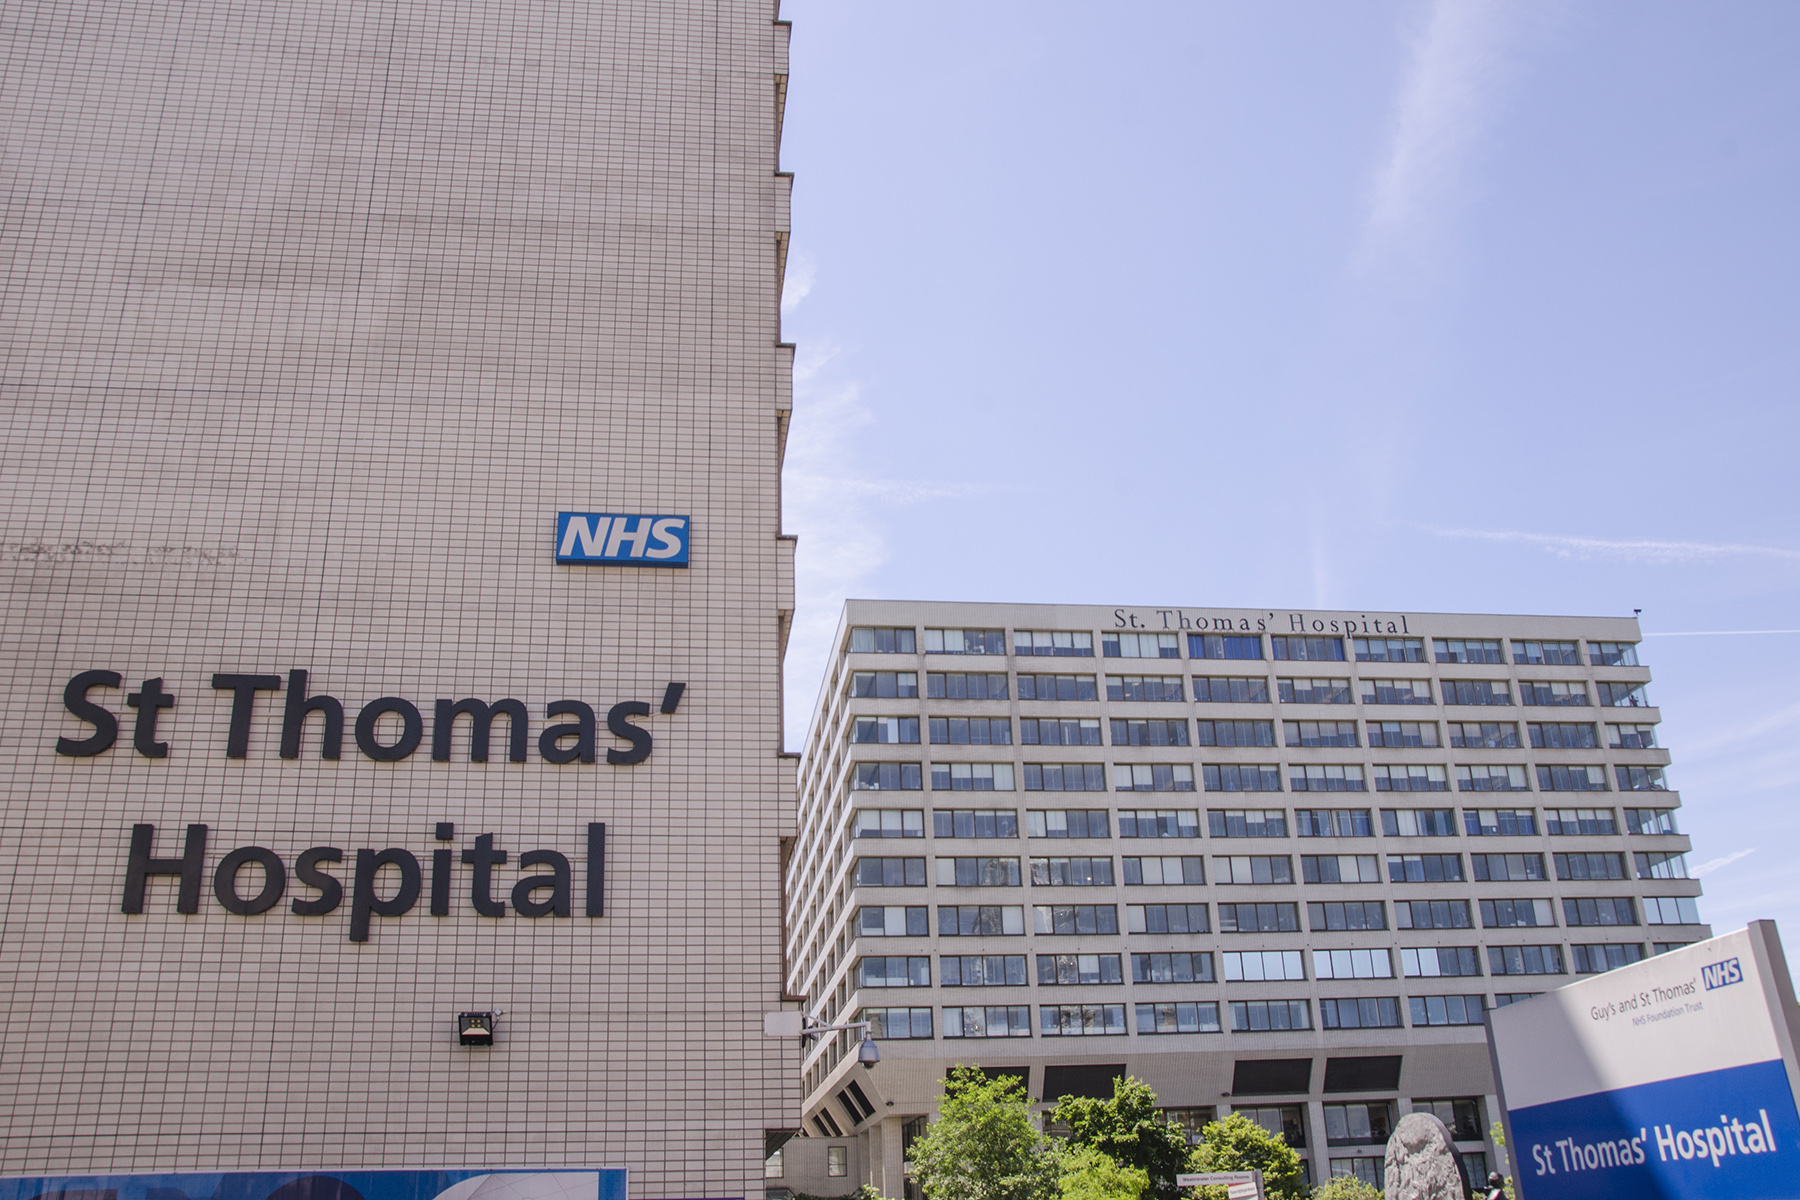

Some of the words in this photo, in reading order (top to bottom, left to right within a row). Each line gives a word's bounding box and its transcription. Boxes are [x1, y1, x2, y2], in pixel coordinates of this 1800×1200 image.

[559, 515, 686, 562] NHS
[1114, 608, 1146, 629] St.
[1156, 609, 1275, 632] Thomas'
[1289, 613, 1410, 639] Hospital
[55, 669, 175, 759] St
[211, 669, 687, 766] Thomas'
[120, 821, 606, 943] Hospital
[1703, 959, 1741, 989] NHS
[1590, 1001, 1617, 1022] Guy's
[1619, 993, 1639, 1014] and
[1639, 991, 1651, 1008] St
[1651, 977, 1697, 1001] Thomas'
[1631, 1015, 1647, 1027] NHS
[1646, 1006, 1685, 1024] Foundation
[1684, 1001, 1704, 1016] Trust
[1532, 1143, 1556, 1176] St
[1555, 1127, 1647, 1173] Thomas'
[1654, 1108, 1777, 1168] Hospital
